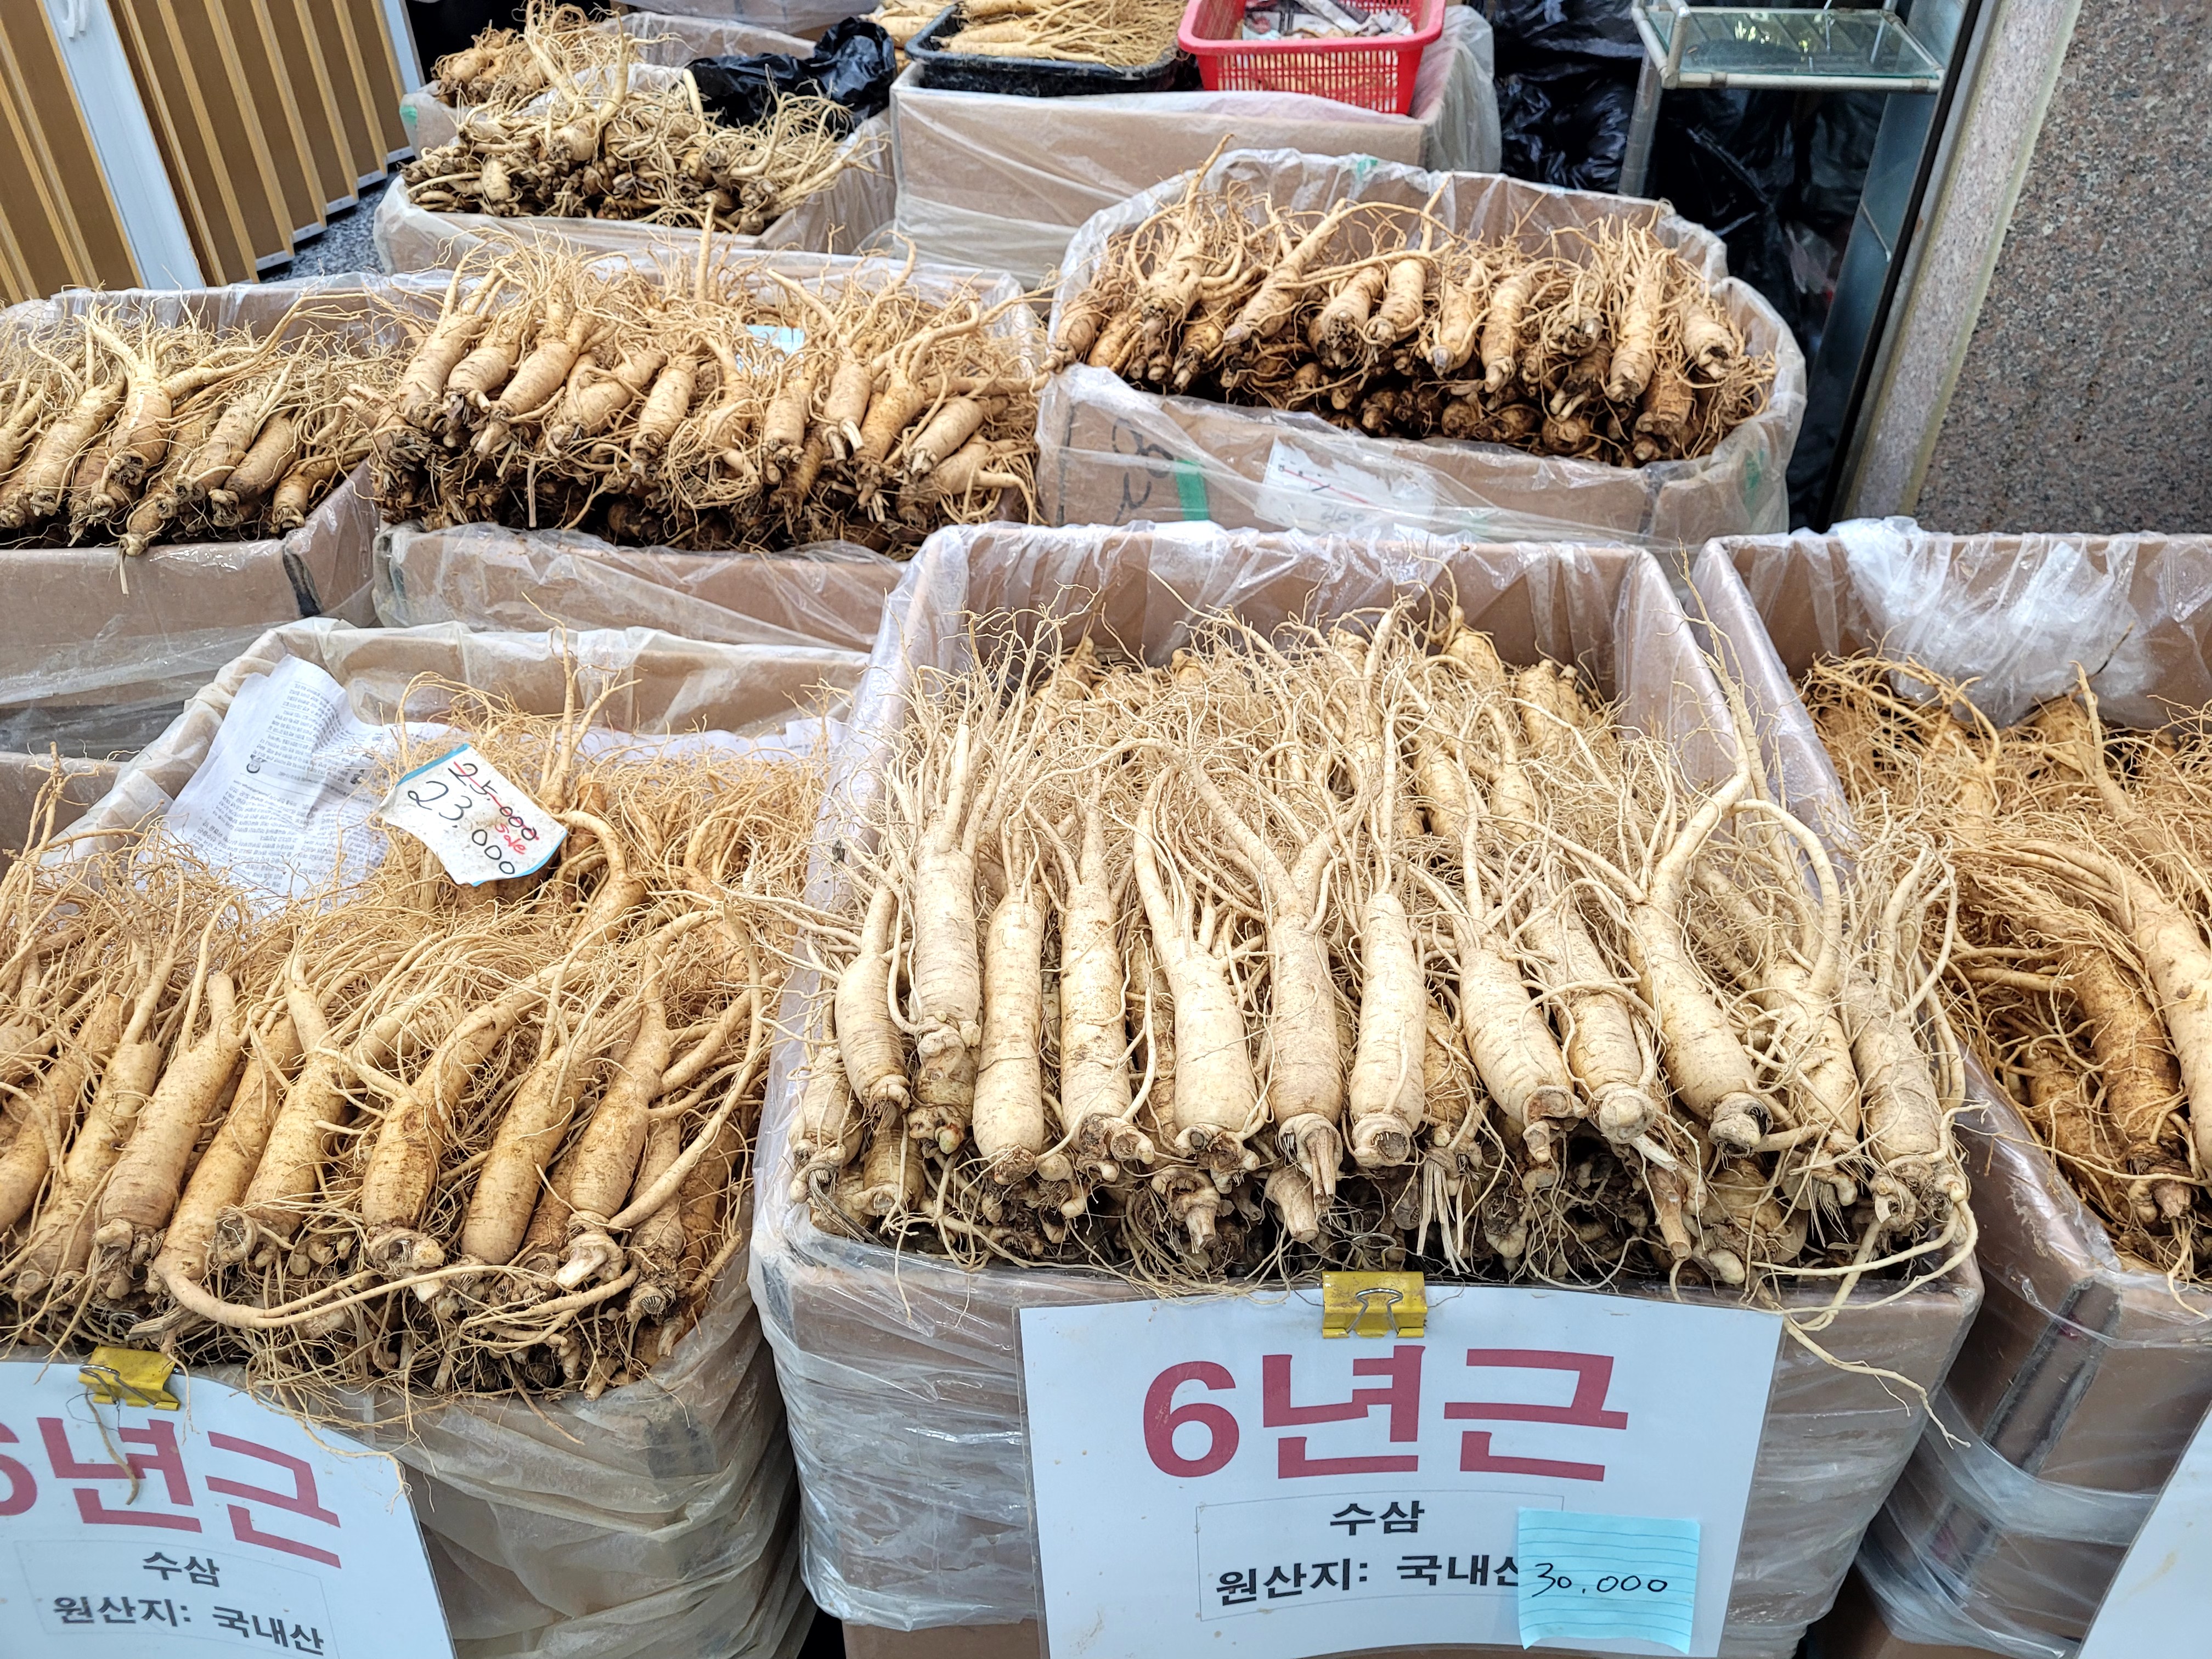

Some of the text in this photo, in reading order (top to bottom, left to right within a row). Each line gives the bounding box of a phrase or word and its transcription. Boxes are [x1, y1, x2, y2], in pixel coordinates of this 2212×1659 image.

[1143, 1345, 1628, 1481] 6년근
[1330, 1500, 1425, 1536] 수삼
[143, 1551, 220, 1588] 수삼
[1215, 1558, 1369, 1606] 원산지:
[53, 1595, 324, 1656] 원산지: 국내산
